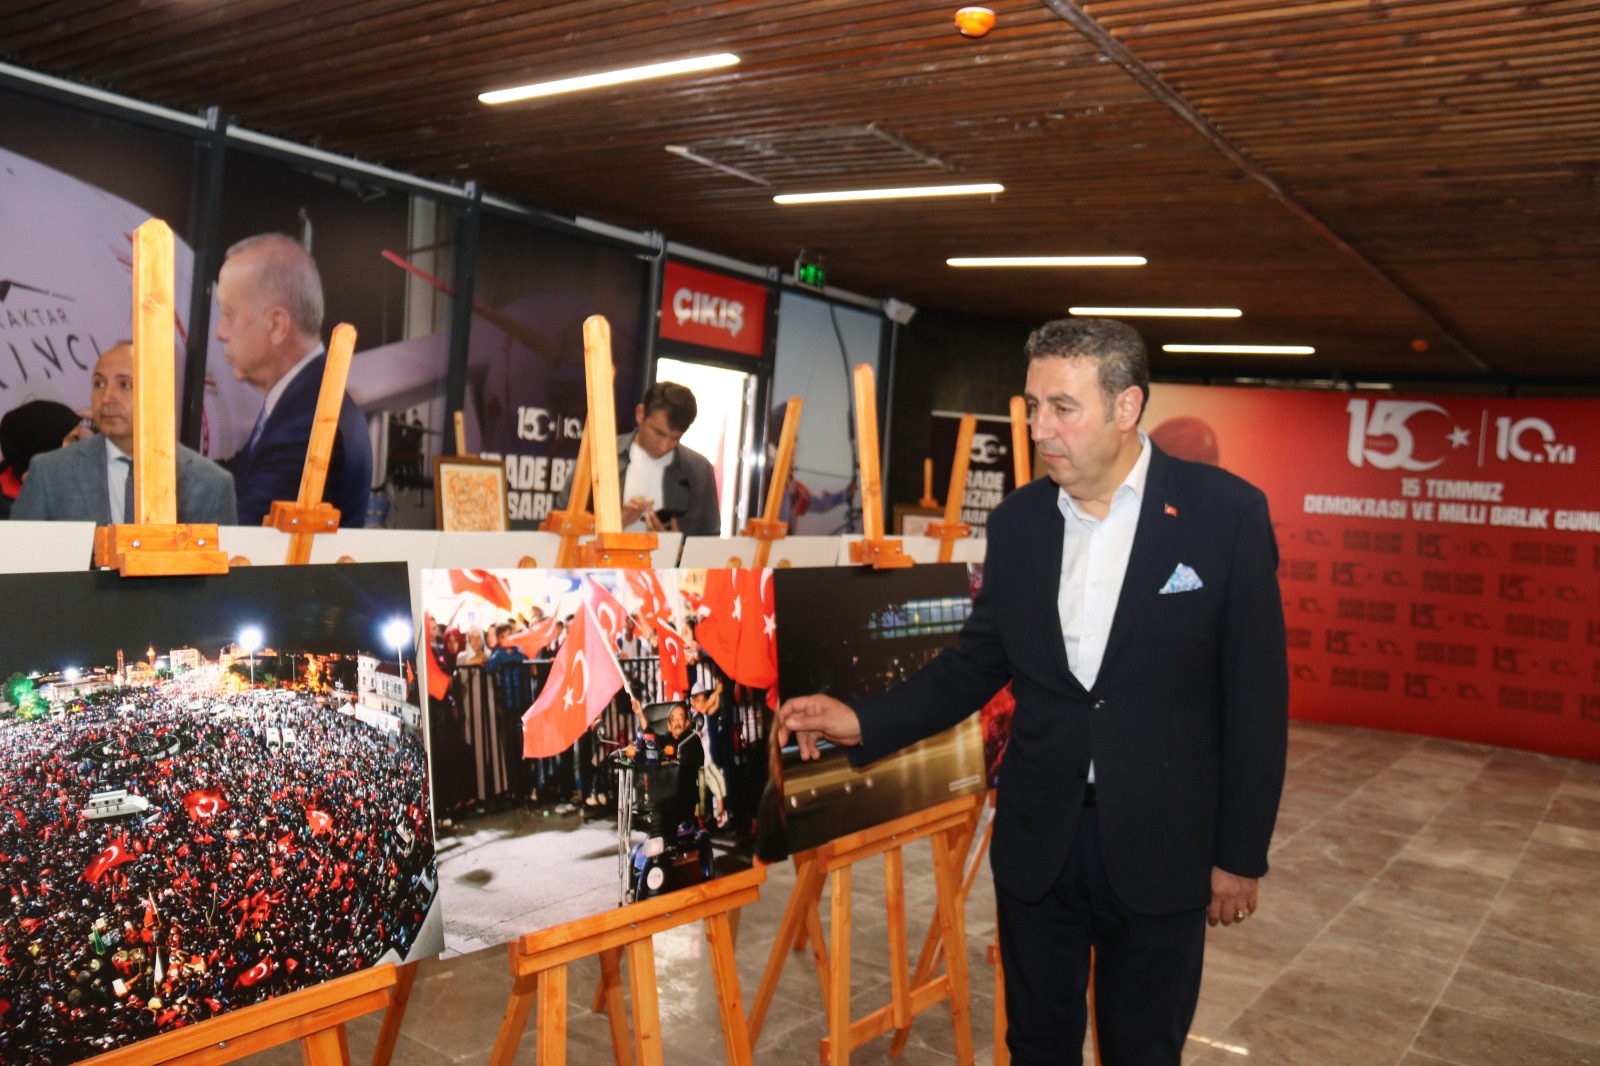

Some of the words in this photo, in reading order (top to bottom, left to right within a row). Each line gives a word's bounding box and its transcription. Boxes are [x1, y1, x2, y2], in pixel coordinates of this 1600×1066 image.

[0, 308, 69, 329] AKTAR
[672, 287, 745, 338] ÇIKIŞ
[0, 333, 101, 389] INCI
[517, 406, 540, 441] 15
[1346, 398, 1416, 470] 15
[1401, 477, 1420, 498] 15
[1426, 478, 1504, 502] TEMMUZ
[1411, 501, 1435, 521] VE
